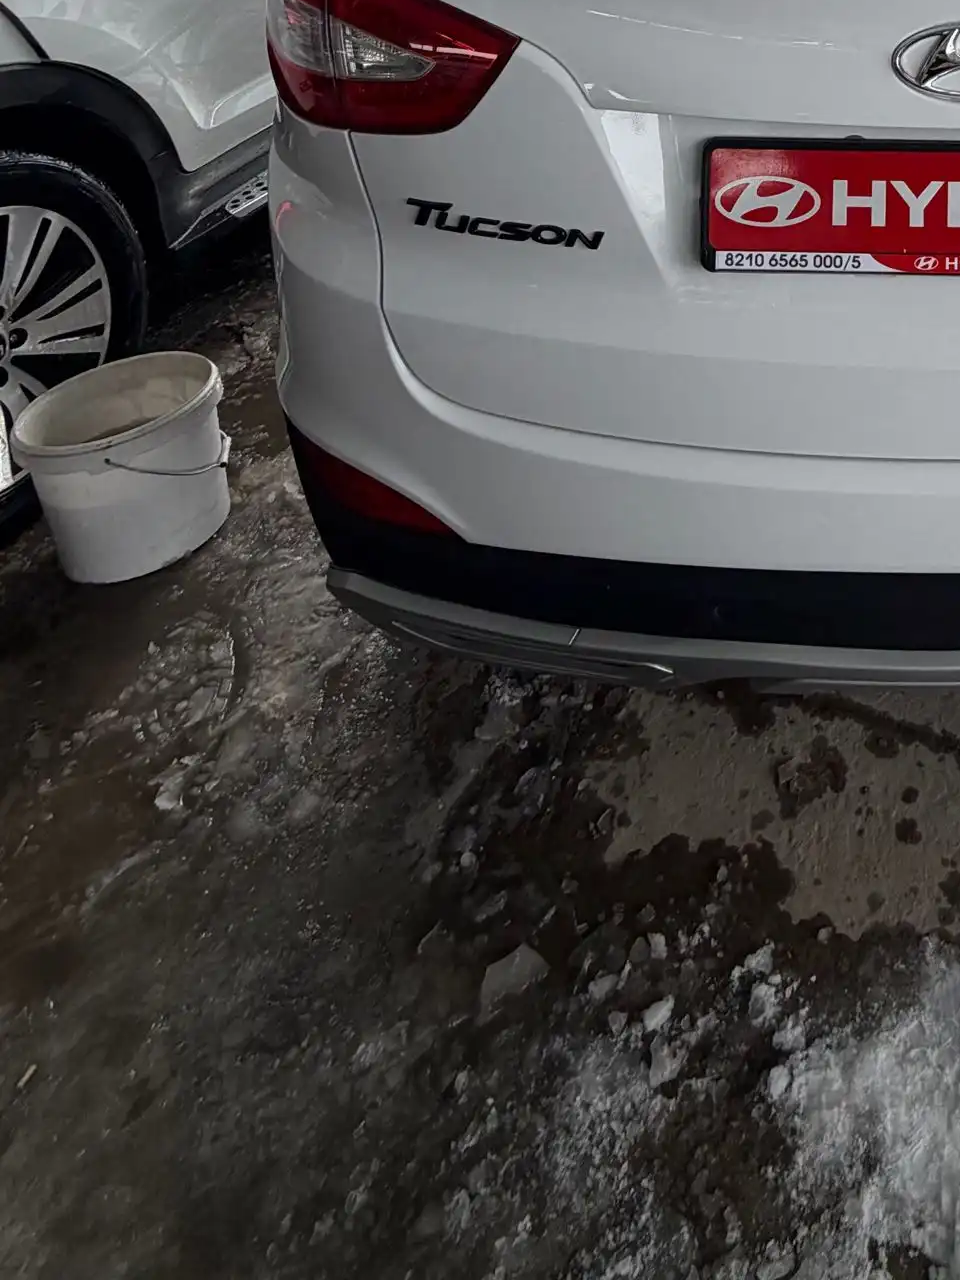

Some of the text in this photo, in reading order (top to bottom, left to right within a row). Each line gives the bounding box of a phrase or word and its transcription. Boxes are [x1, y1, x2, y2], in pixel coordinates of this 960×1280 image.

[724, 252, 862, 271] 8210 6565 000/5
